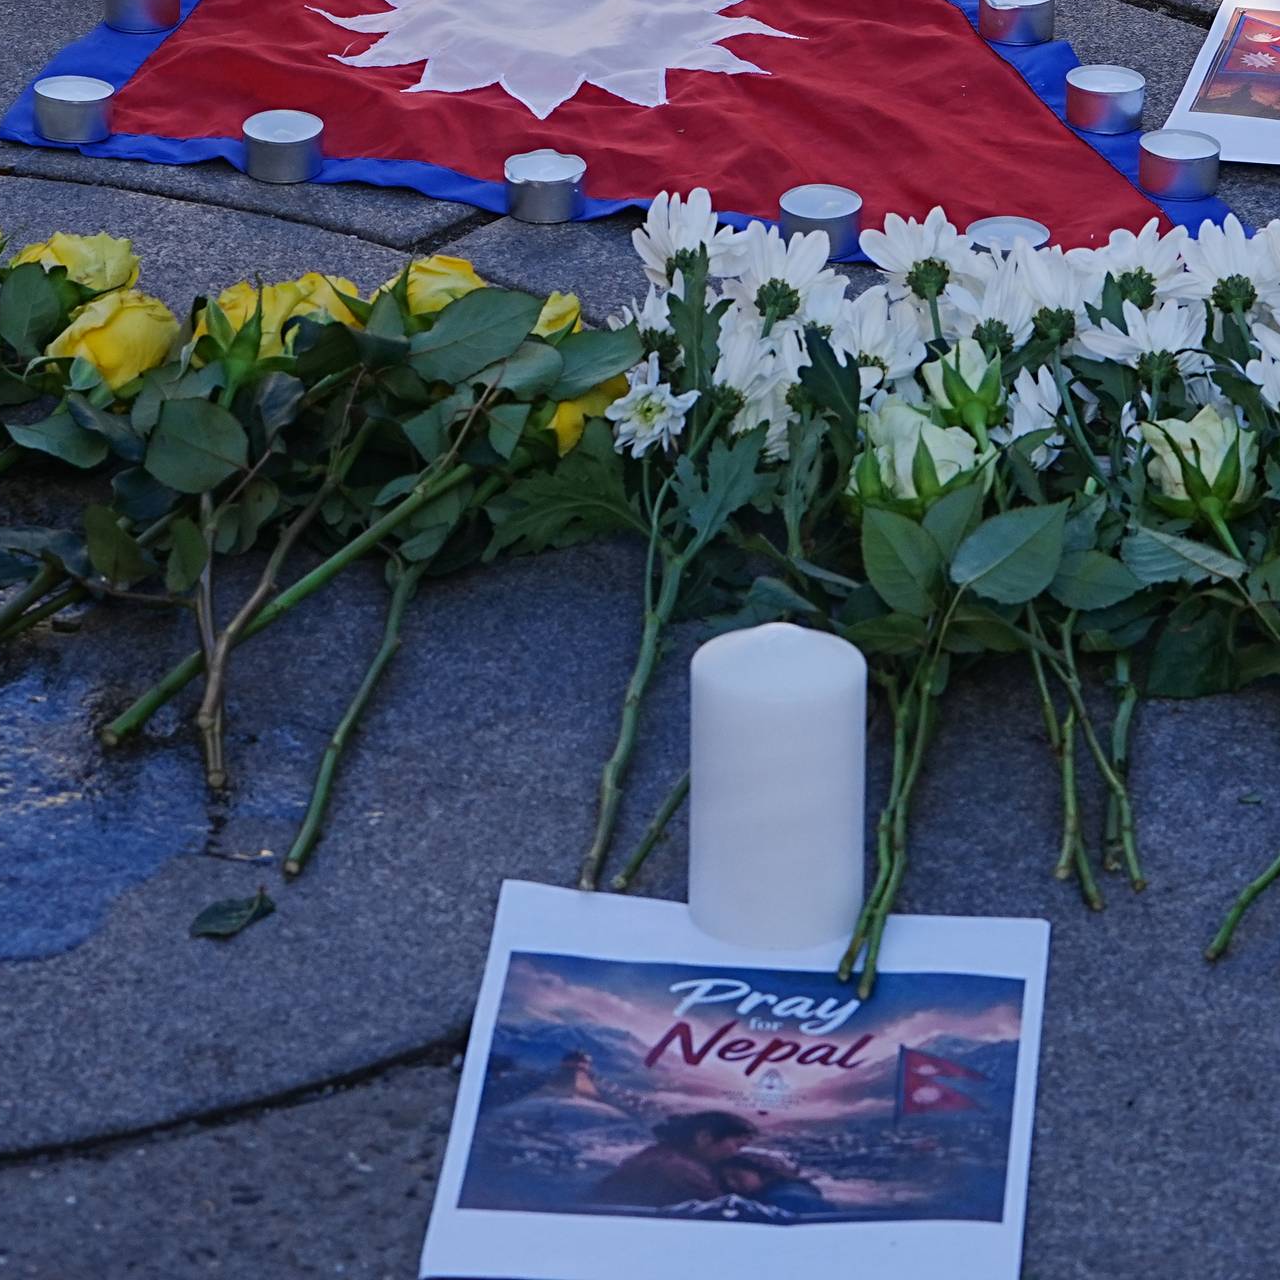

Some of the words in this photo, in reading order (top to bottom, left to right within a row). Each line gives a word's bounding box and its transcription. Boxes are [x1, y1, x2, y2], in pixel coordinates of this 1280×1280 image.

[670, 978, 861, 1036] Pray
[749, 1017, 784, 1031] for
[643, 1021, 875, 1077] Nepal
